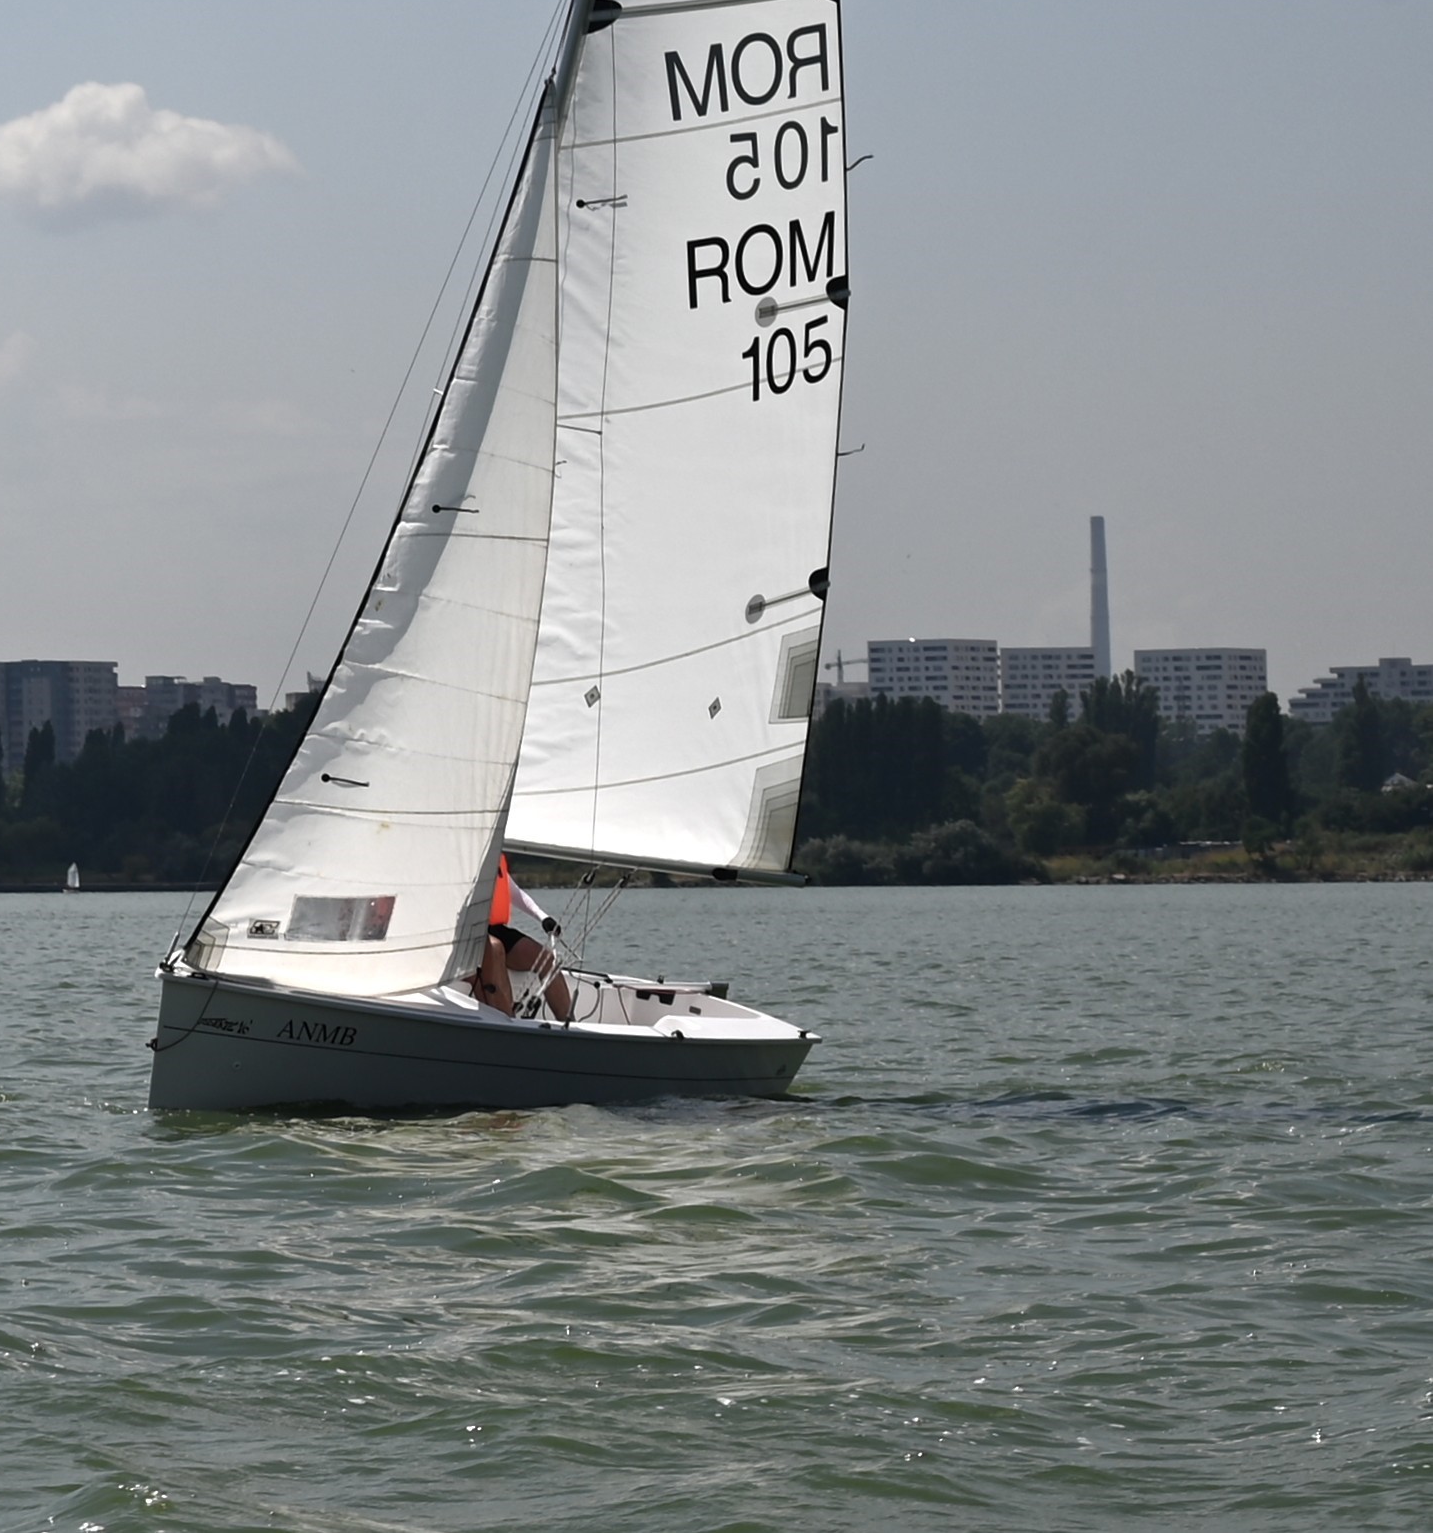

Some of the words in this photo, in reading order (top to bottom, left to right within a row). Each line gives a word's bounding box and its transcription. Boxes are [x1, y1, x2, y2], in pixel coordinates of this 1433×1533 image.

[686, 211, 835, 309] ROM
[742, 315, 832, 402] 105
[276, 1019, 357, 1046] ANMB
